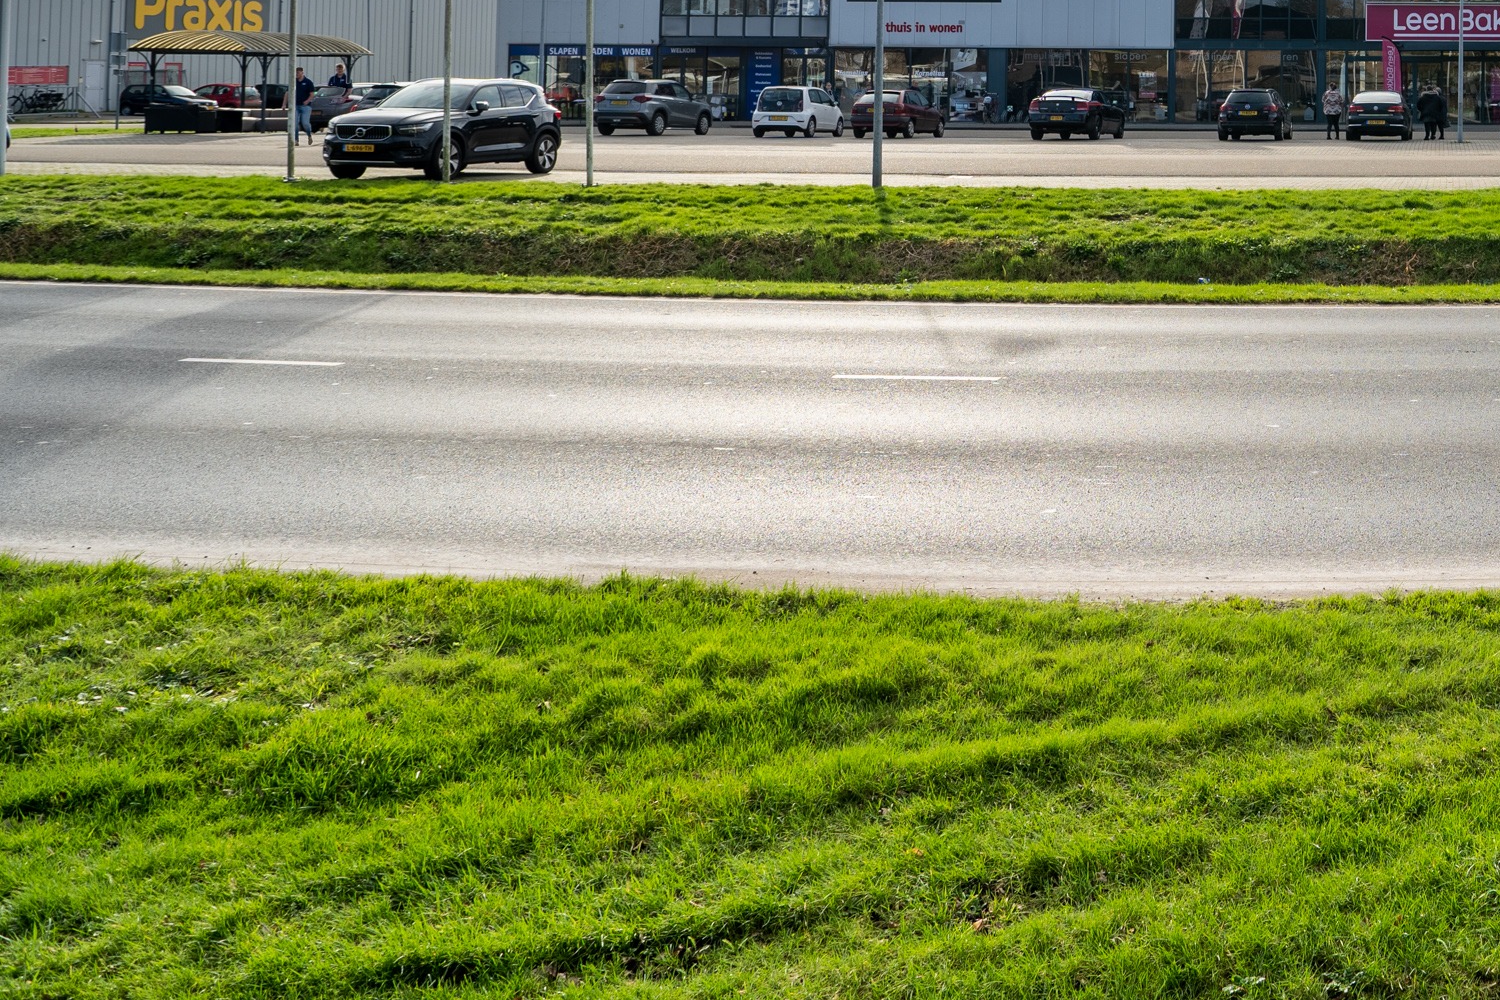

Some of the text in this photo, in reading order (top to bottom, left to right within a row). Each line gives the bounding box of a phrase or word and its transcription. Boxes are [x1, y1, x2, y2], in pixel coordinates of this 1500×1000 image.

[885, 22, 963, 33] thuis in wonen
[549, 47, 651, 56] SLAPEN ADEN WONEN
